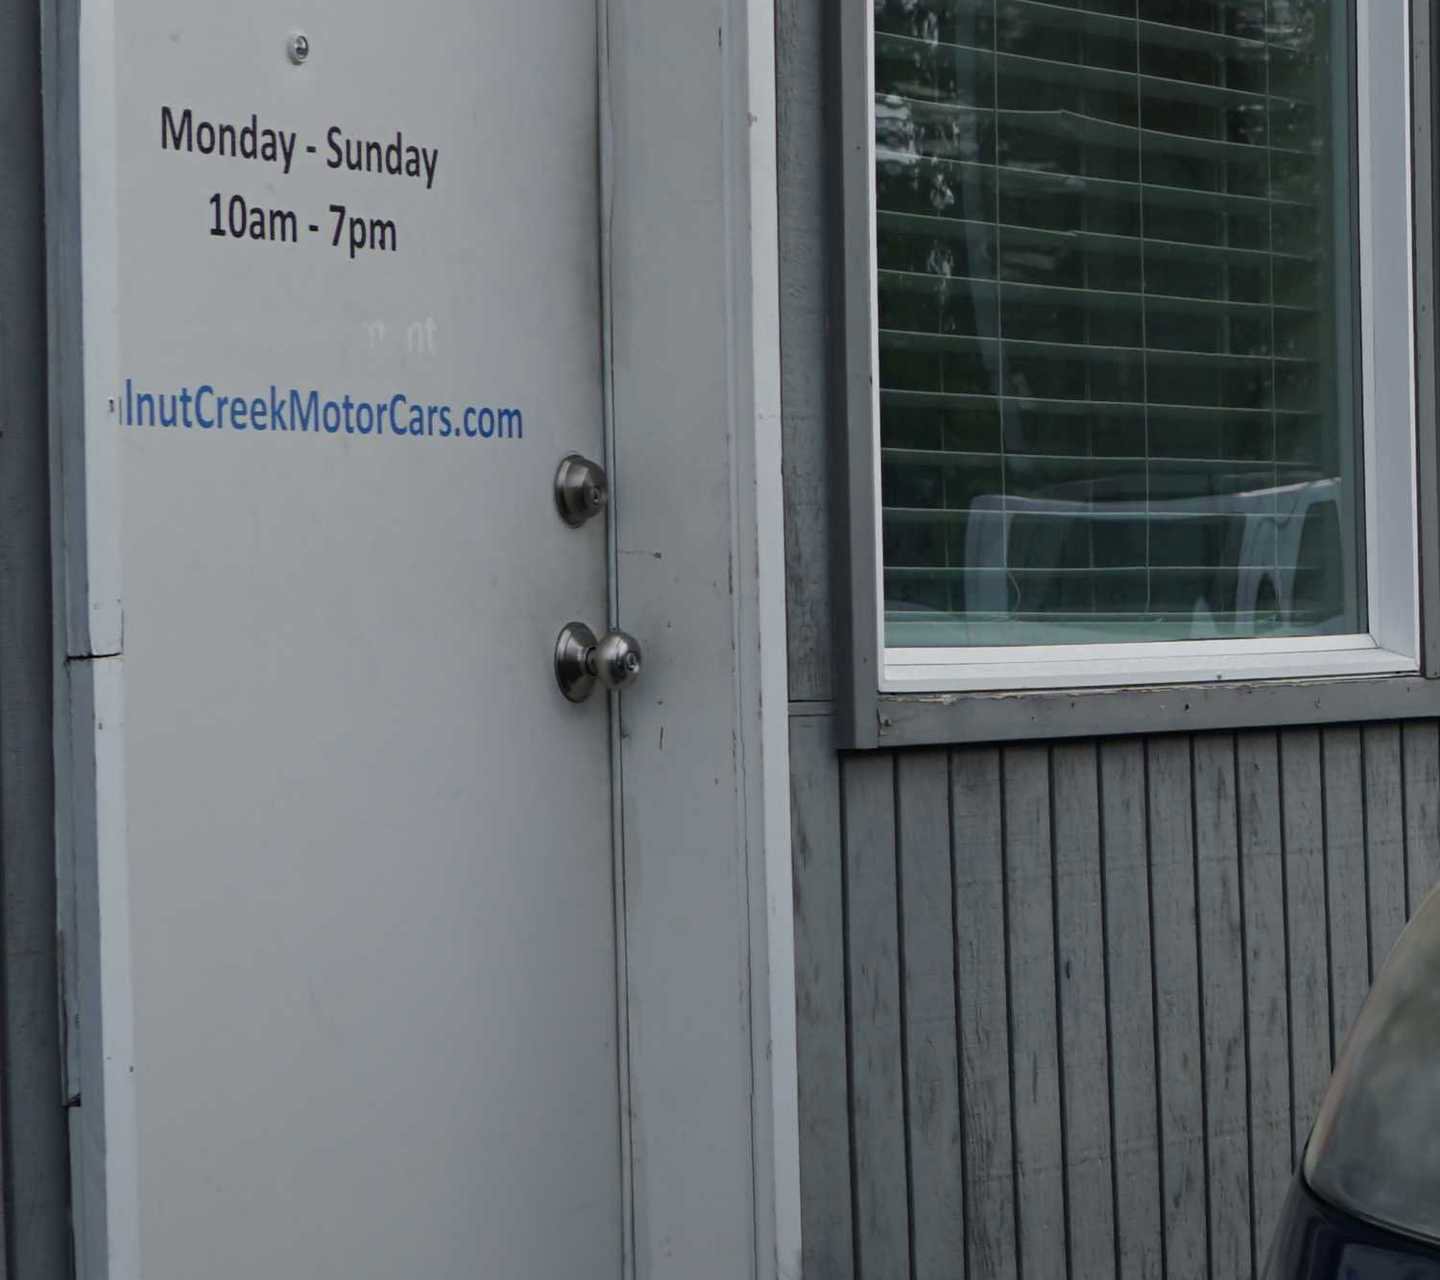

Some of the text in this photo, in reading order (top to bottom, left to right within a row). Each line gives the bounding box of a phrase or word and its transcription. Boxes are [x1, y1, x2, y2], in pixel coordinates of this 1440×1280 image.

[161, 106, 297, 173] Monday
[327, 126, 438, 189] Sunday
[209, 193, 298, 242] 10am
[329, 204, 397, 258] 7pm
[118, 379, 523, 438] lnutCreekMotorCars.com
